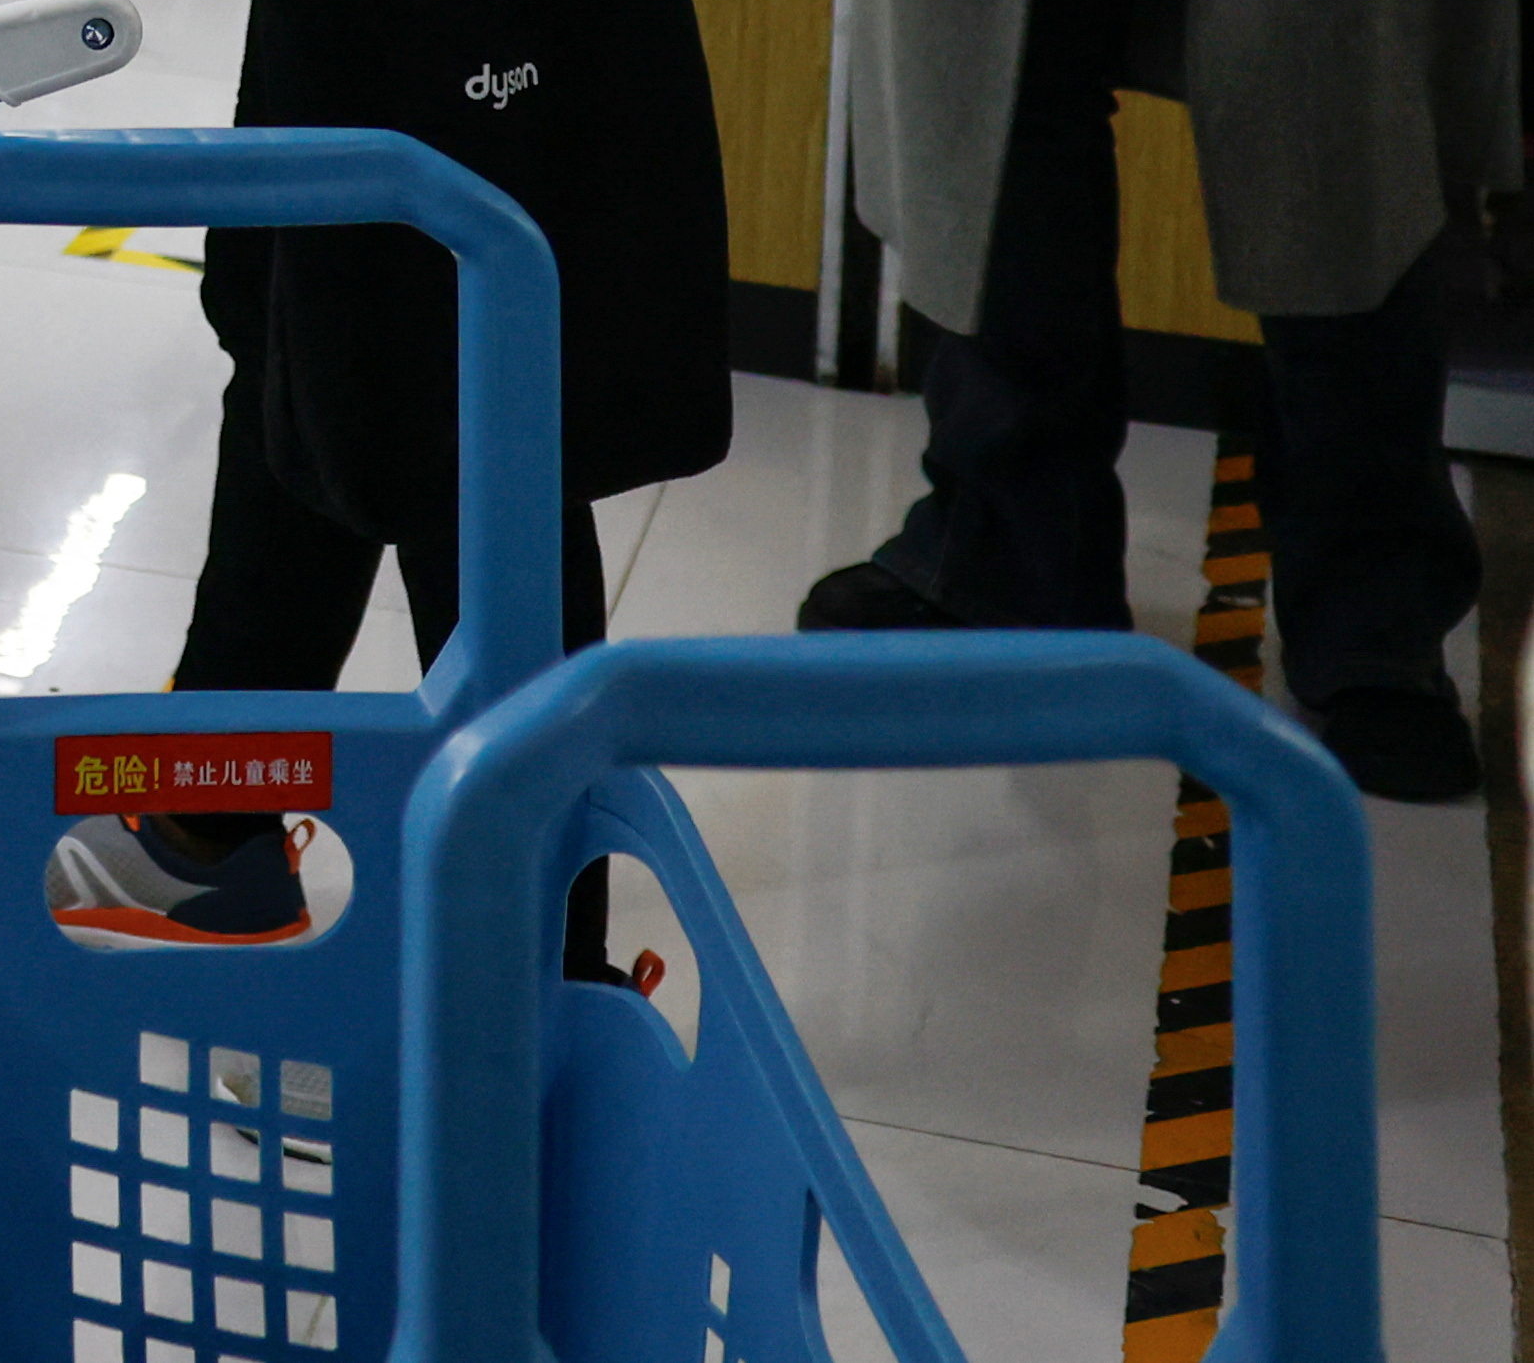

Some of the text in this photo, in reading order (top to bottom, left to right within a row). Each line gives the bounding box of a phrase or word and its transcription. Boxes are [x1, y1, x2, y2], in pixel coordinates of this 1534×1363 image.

[465, 62, 539, 110] dyson
[74, 754, 313, 795] 危险! 禁止儿童乘坐
